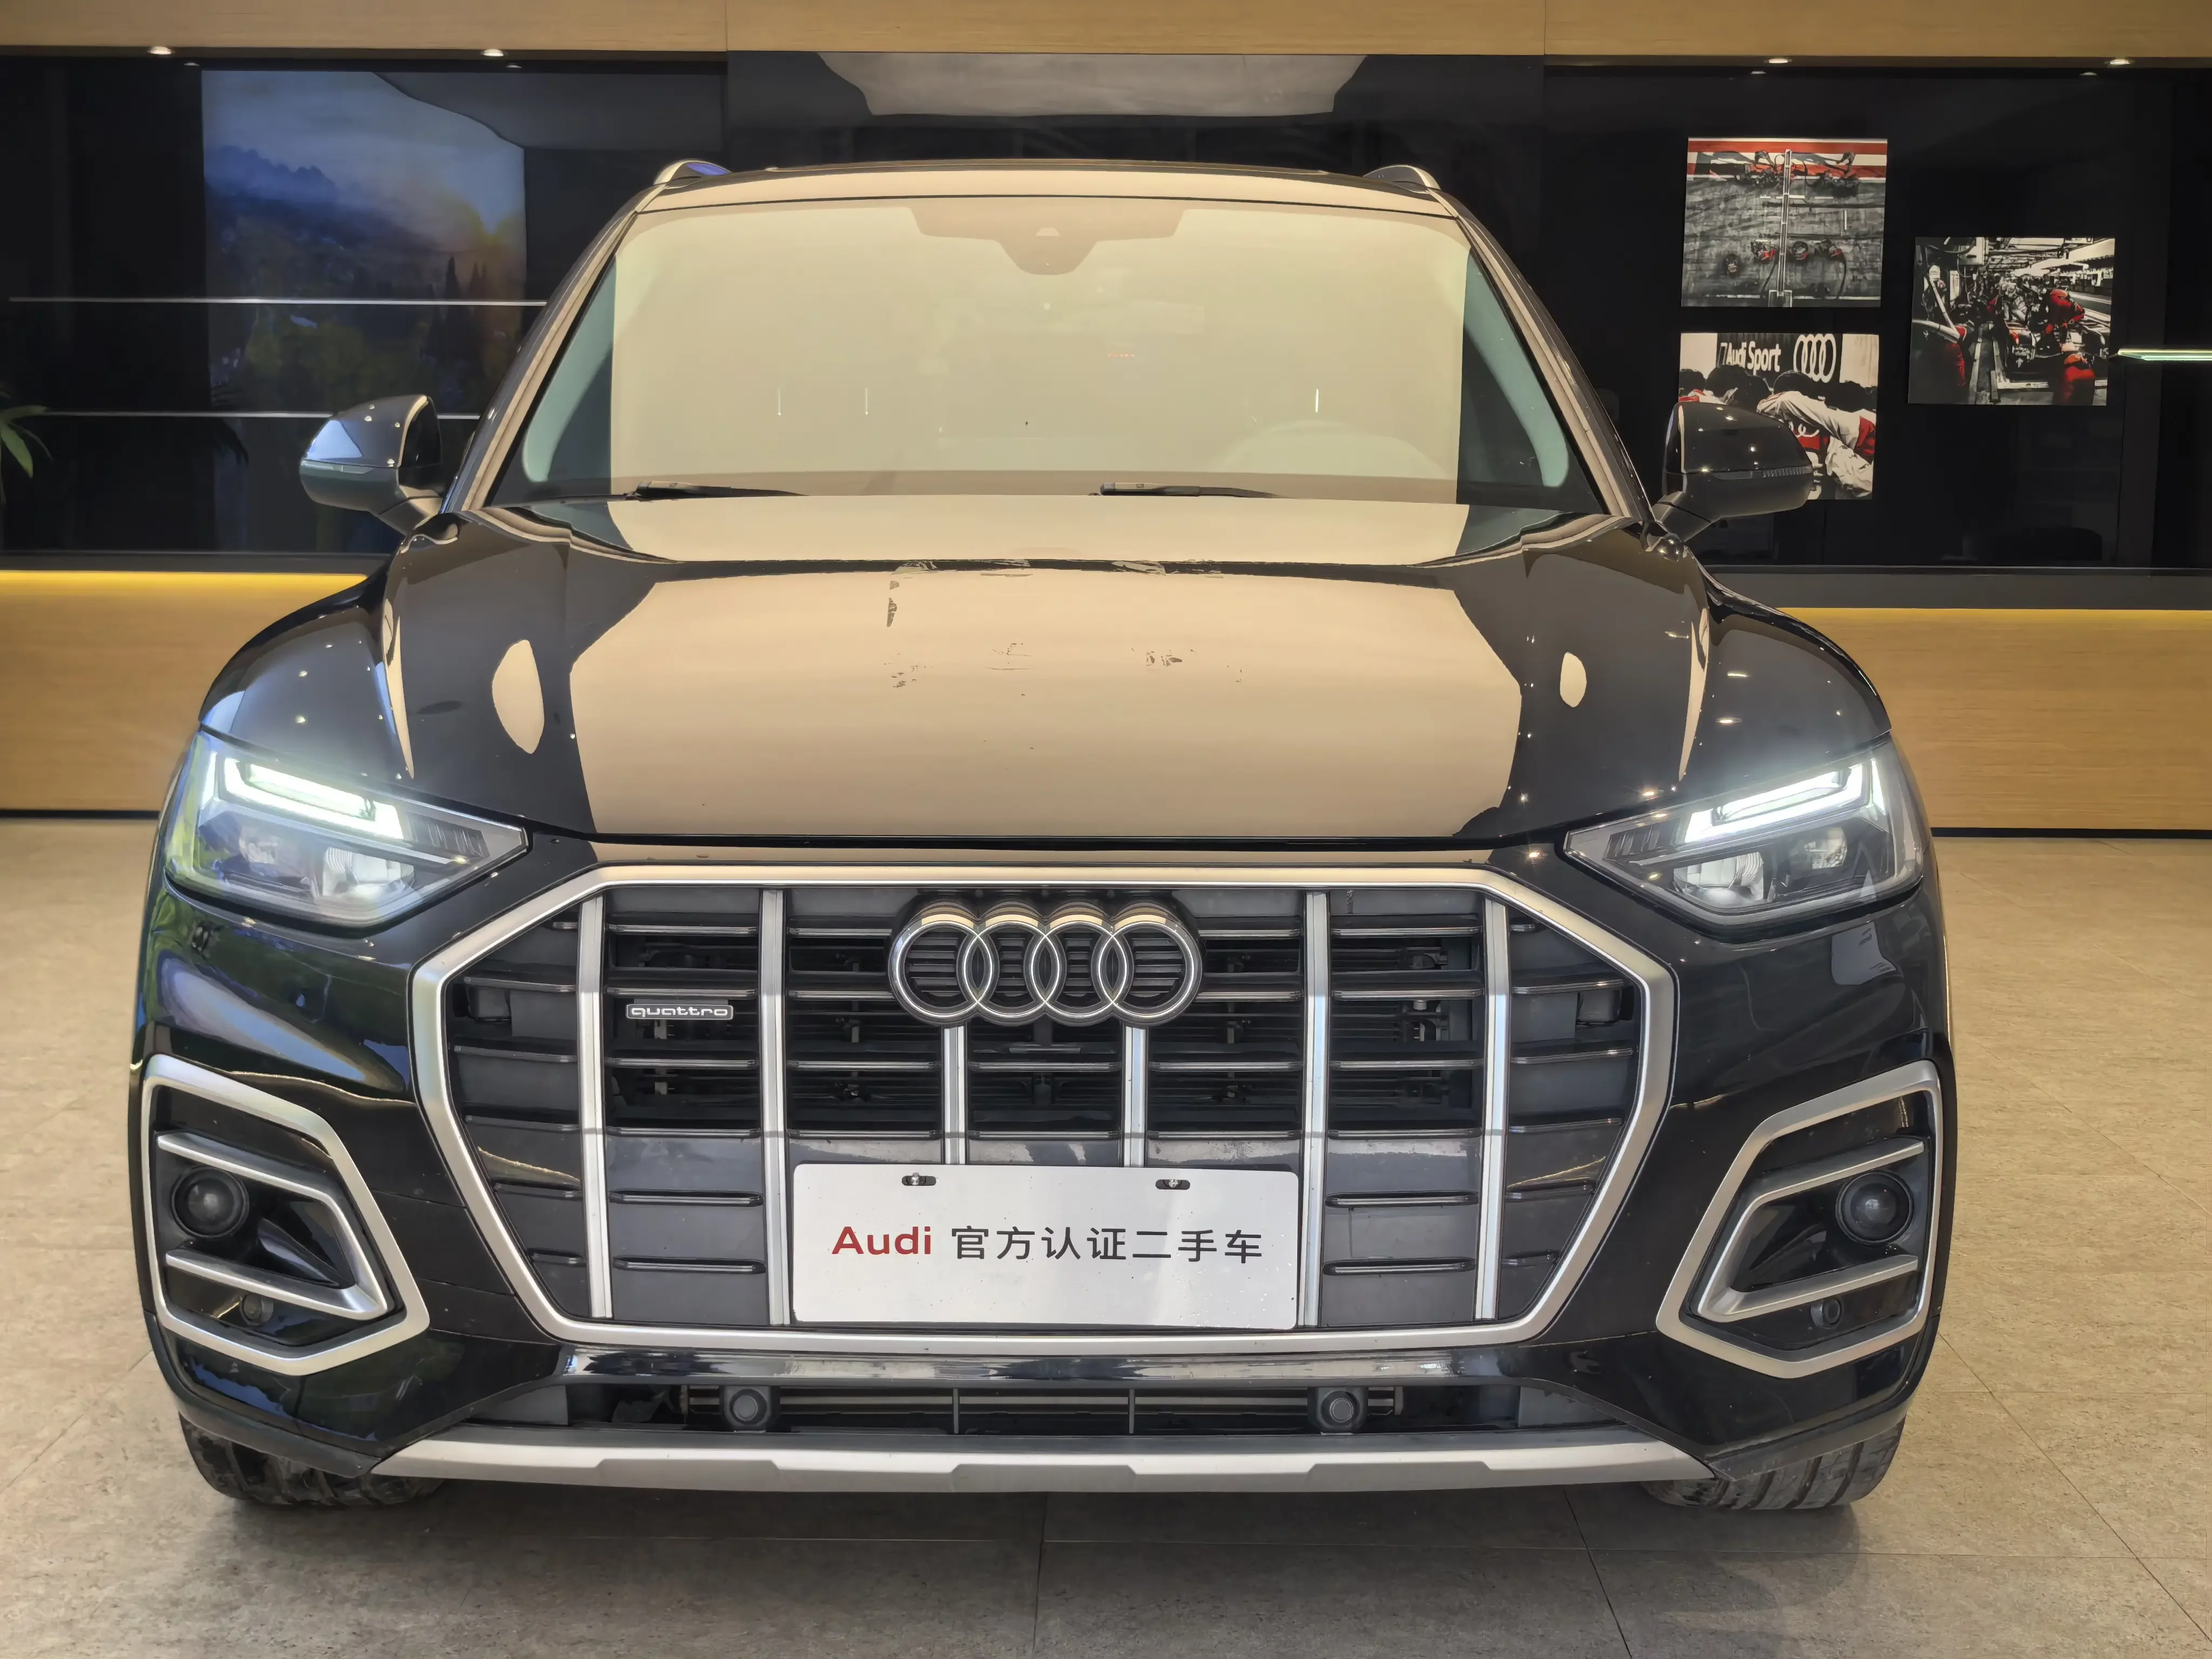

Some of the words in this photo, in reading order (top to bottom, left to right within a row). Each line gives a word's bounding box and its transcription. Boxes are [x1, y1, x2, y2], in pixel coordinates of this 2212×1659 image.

[1726, 341, 1747, 368] Audi
[1747, 341, 1782, 375] Sport
[631, 1007, 729, 1017] quattro
[832, 1226, 931, 1256] Audi
[952, 1225, 1262, 1264] 官方认证二手车
